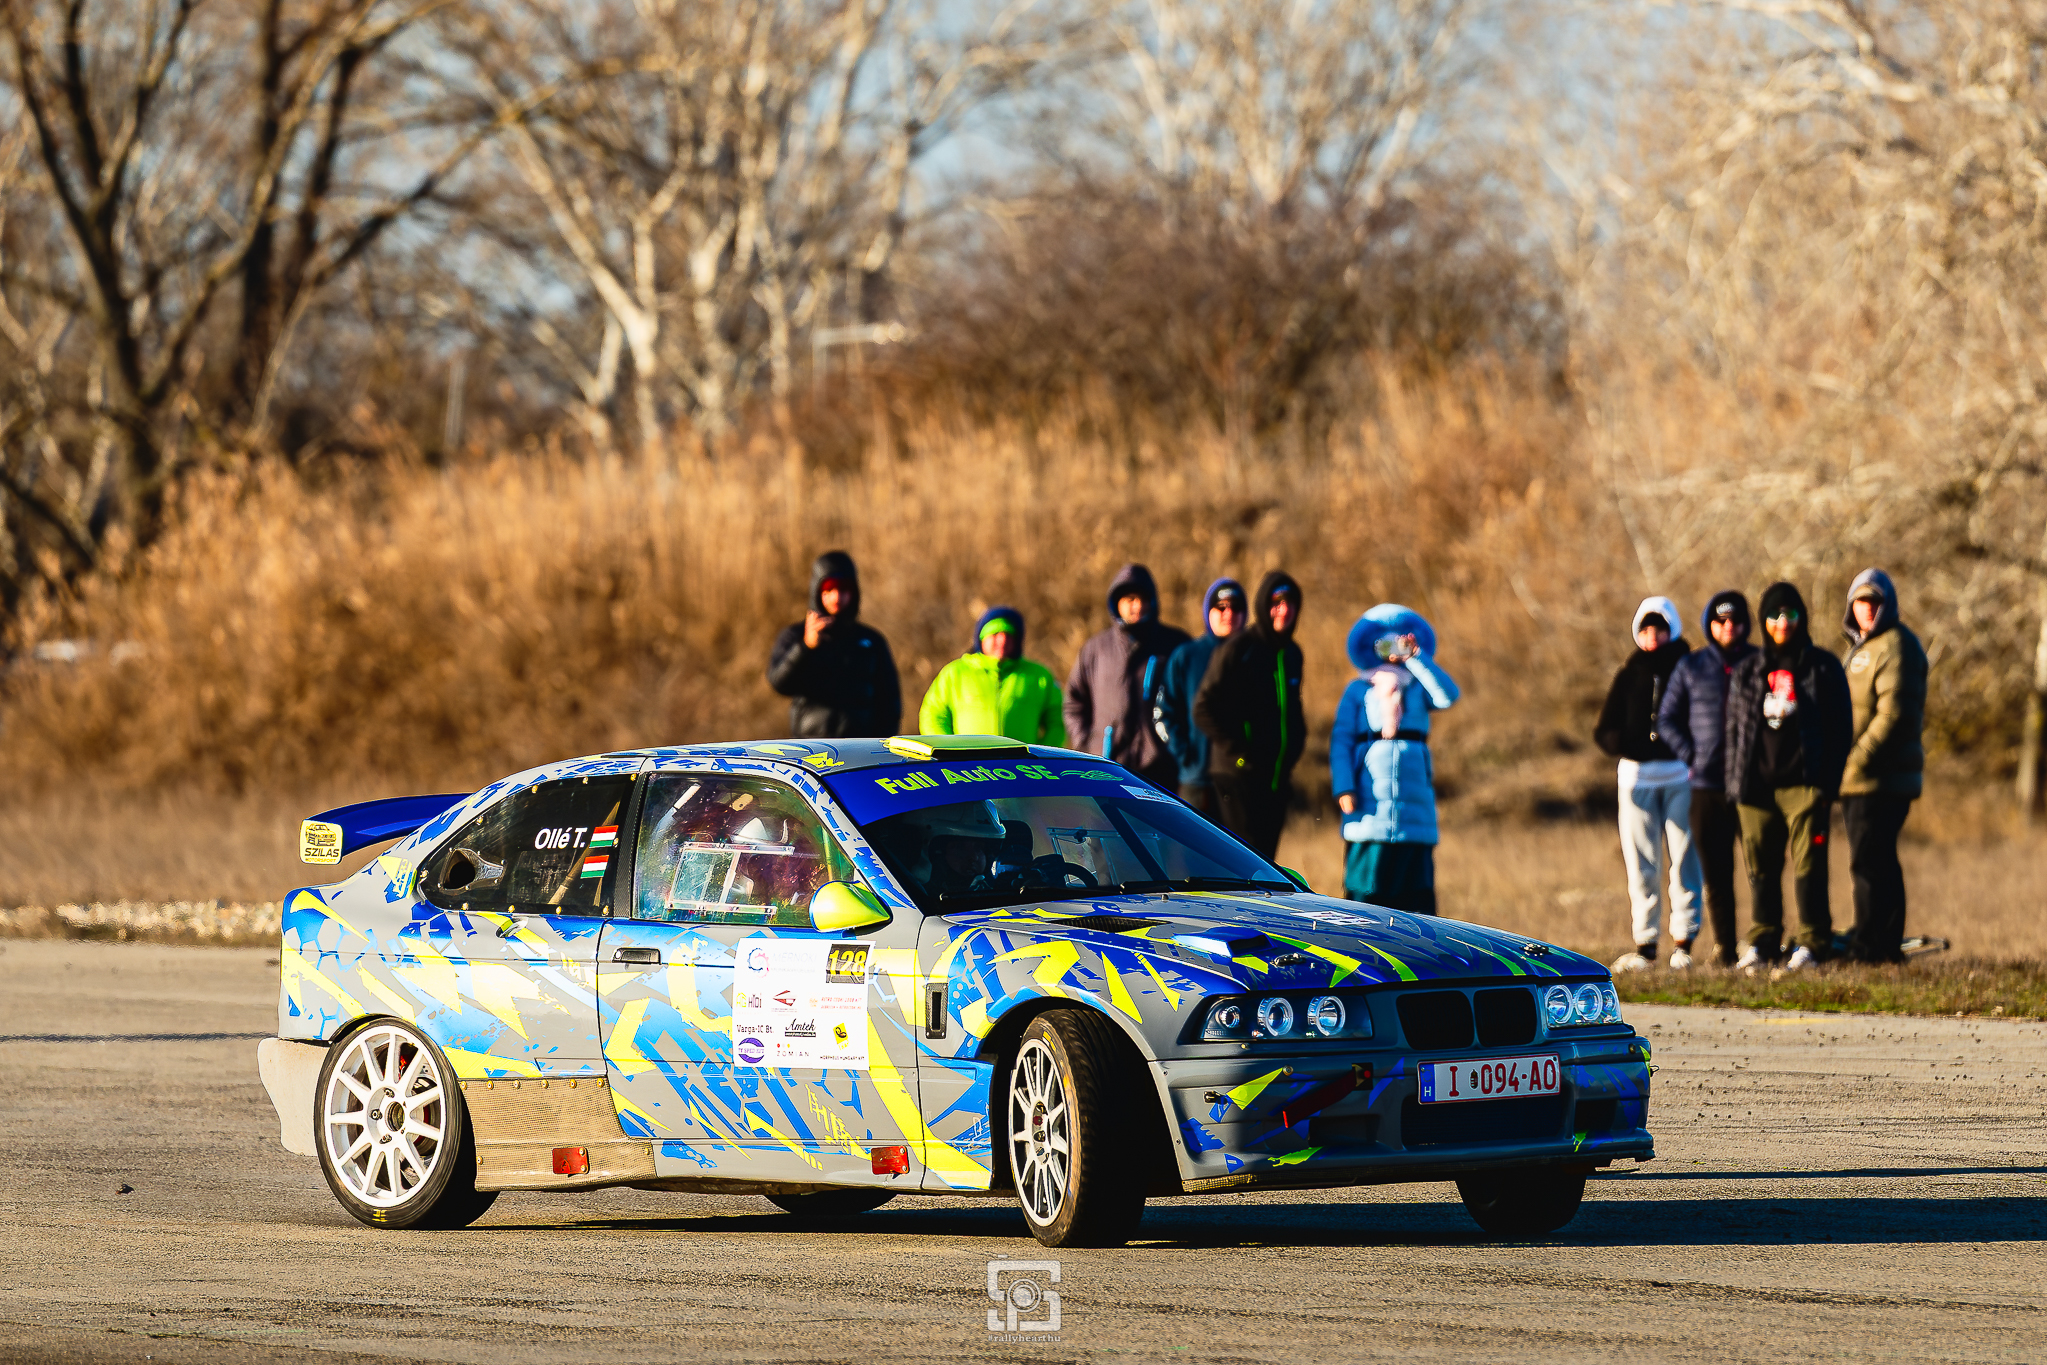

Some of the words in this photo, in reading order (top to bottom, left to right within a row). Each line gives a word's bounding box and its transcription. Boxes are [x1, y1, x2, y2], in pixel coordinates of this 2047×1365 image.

[874, 771, 940, 795] Full
[941, 765, 1017, 785] Auto
[1015, 764, 1061, 780] SE
[534, 827, 573, 850] Ollé
[573, 827, 588, 849] T.
[304, 847, 340, 858] SZILAS
[829, 949, 867, 977] 128
[1424, 1086, 1432, 1097] H
